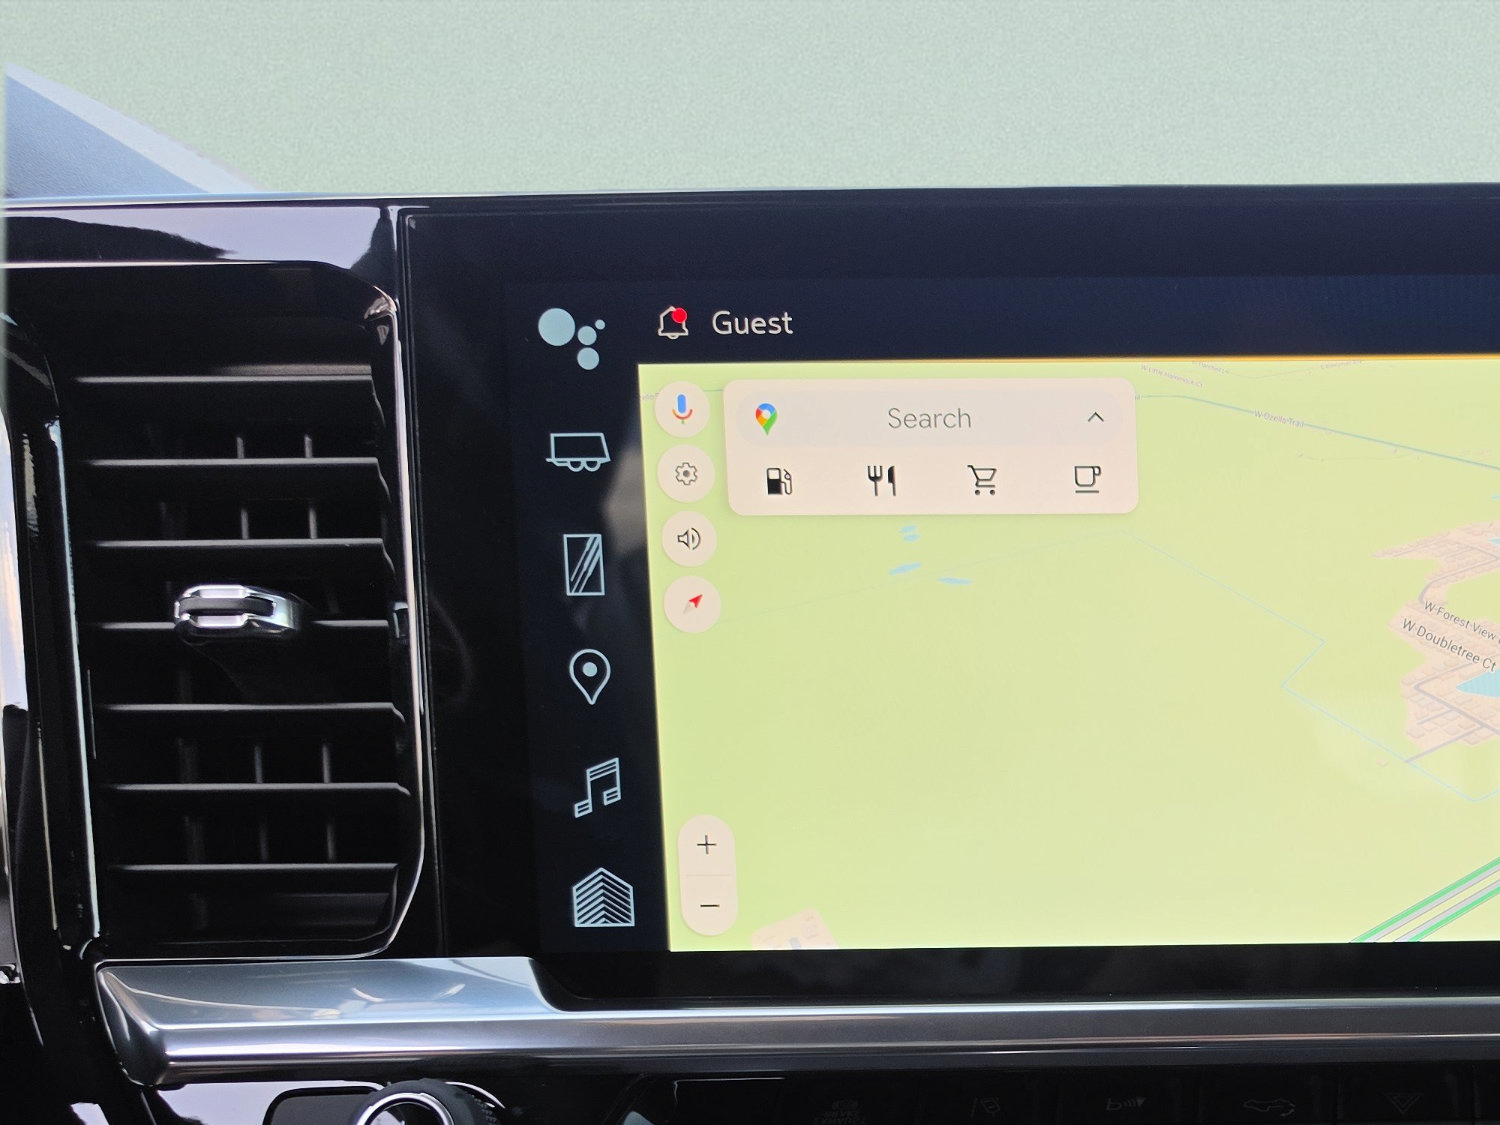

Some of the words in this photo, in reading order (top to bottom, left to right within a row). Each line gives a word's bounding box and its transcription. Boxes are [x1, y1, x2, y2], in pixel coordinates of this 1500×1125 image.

[711, 311, 794, 336] Guest
[887, 407, 972, 431] Search
[1424, 600, 1436, 613] W
[1436, 606, 1470, 629] Forest
[1472, 621, 1497, 641] View
[1402, 617, 1416, 632] W
[1416, 625, 1481, 664] Doubletree
[1482, 657, 1497, 673] Ct
